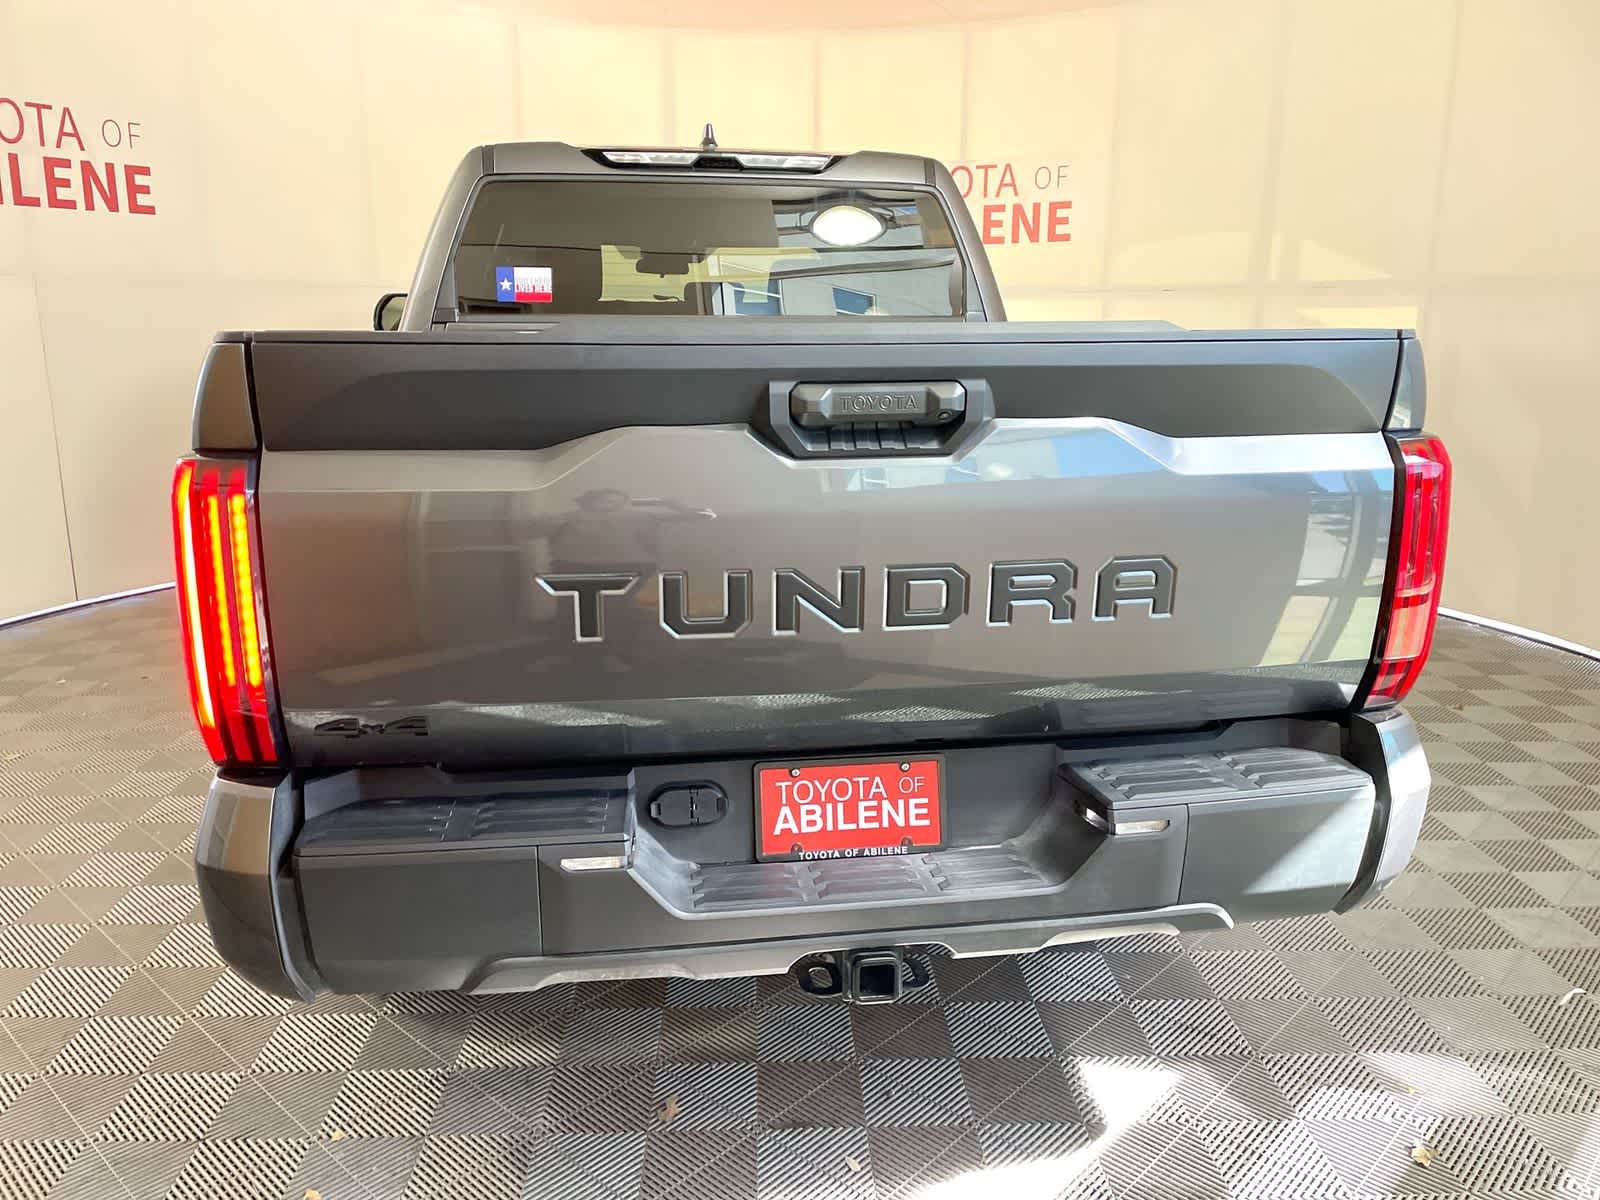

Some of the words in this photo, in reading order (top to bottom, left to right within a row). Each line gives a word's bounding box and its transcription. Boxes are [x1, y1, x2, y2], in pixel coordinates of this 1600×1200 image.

[102, 118, 141, 149] OF
[0, 152, 156, 215] LENE
[1034, 164, 1070, 190] OF
[840, 394, 920, 412] TOYOTA
[534, 553, 1179, 644] TUNDRA
[776, 776, 888, 804] TOYOTA
[899, 776, 926, 793] OF
[773, 798, 931, 835] ABILENE
[799, 851, 840, 861] TOYOTA
[844, 849, 859, 857] OF
[863, 846, 908, 856] ABILENE
